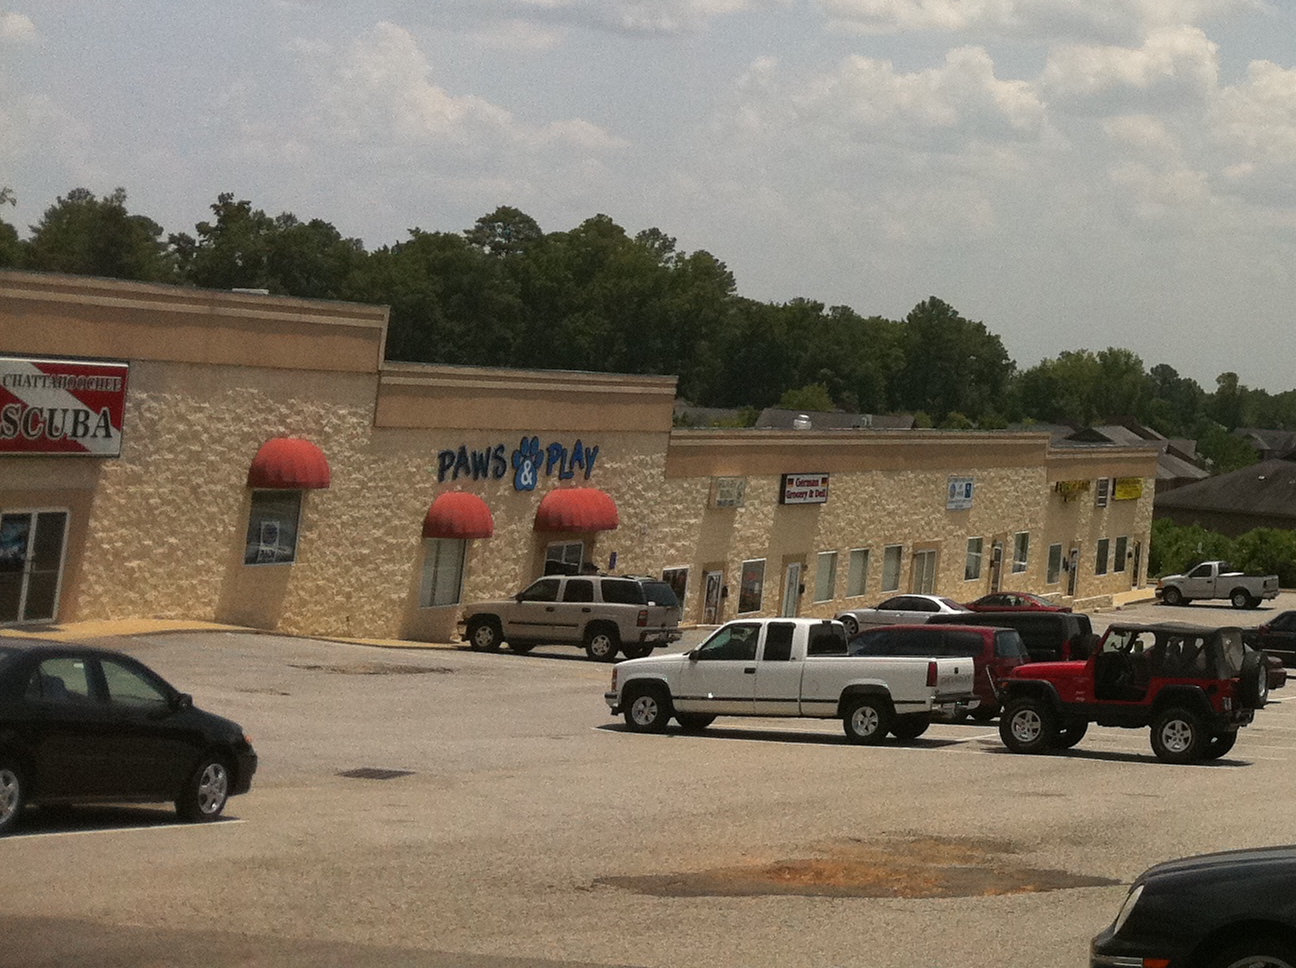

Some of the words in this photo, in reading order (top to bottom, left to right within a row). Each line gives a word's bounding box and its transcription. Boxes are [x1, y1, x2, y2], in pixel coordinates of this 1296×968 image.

[2, 373, 122, 392] CHATTAHOOCHEE
[0, 404, 113, 439] SCUBA
[437, 443, 508, 482] PAWS
[520, 459, 533, 485] &
[546, 438, 599, 480] PLAY
